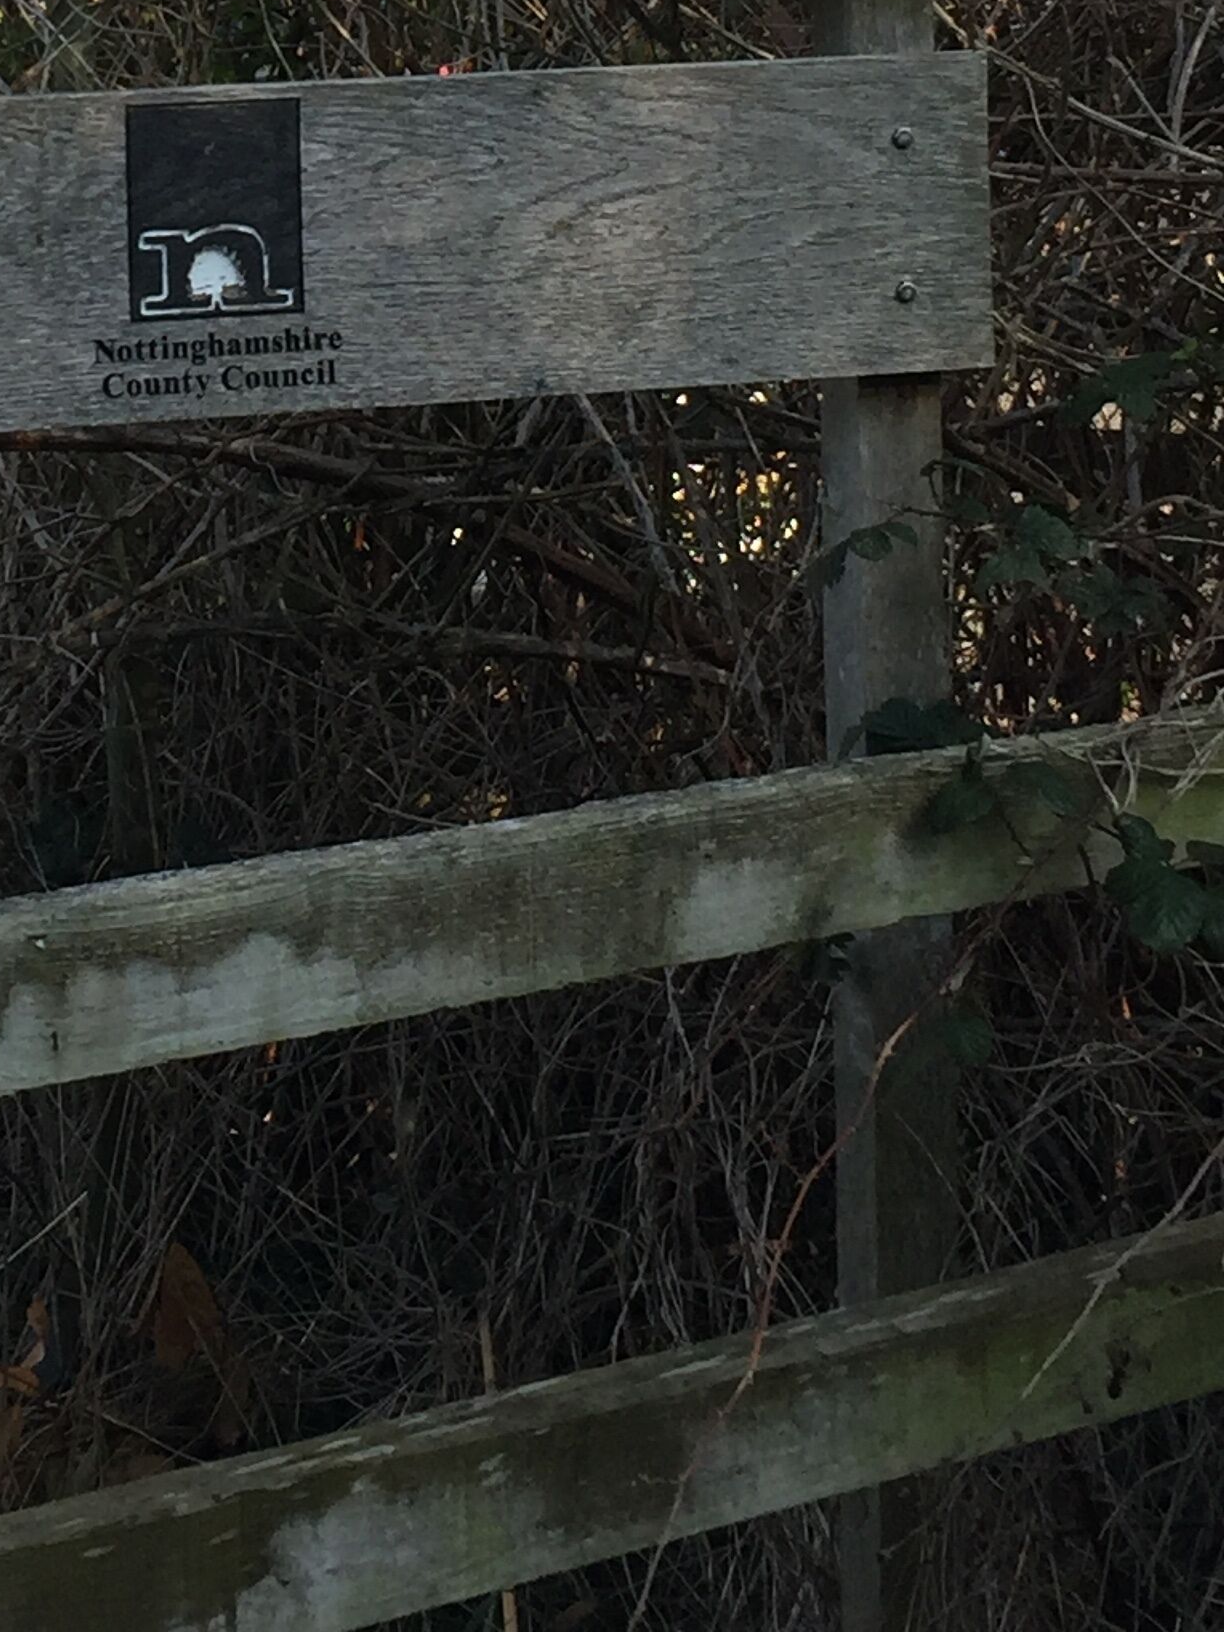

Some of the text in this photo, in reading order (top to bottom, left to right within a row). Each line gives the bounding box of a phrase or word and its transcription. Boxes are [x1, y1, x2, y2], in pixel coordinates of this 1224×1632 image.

[94, 327, 343, 365] Nottinghamshire
[102, 359, 336, 399] County Council
